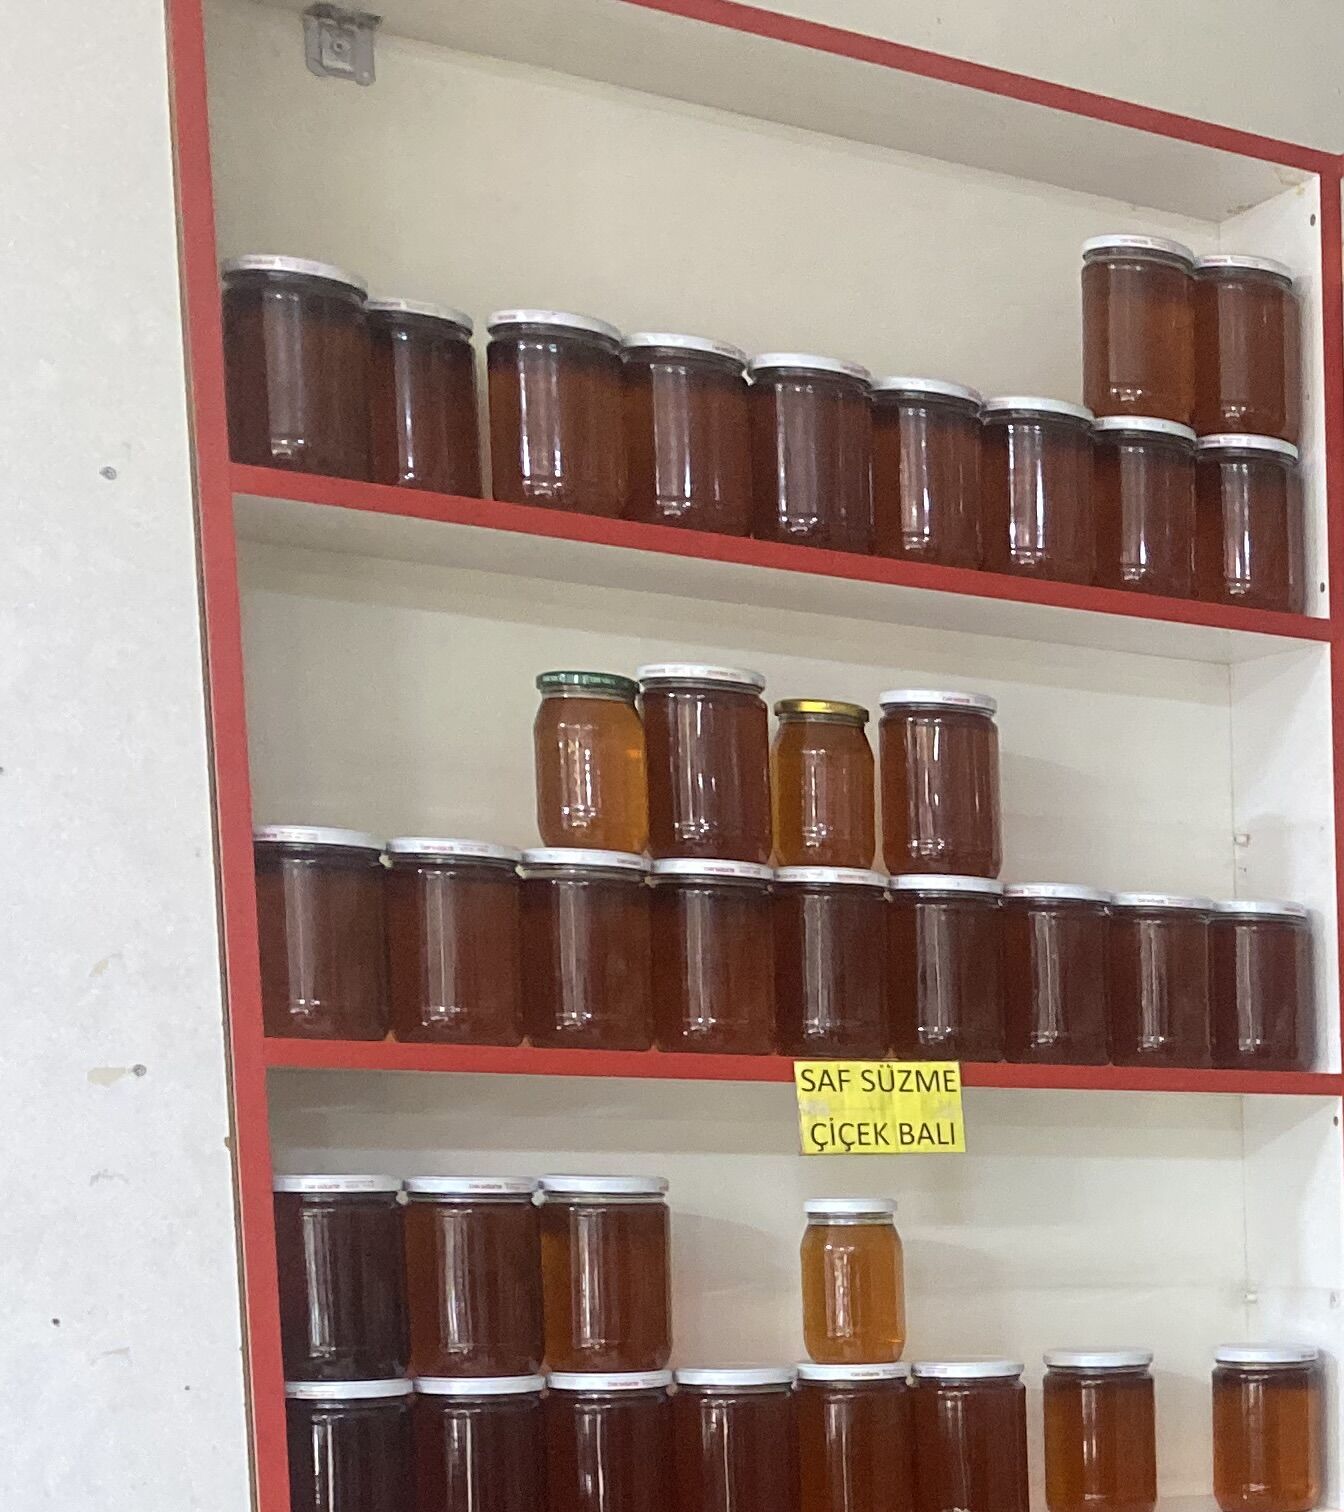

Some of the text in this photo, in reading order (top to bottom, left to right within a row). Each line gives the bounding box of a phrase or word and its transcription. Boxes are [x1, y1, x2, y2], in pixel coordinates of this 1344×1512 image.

[801, 1064, 958, 1093] SAF SÜZME
[810, 1117, 956, 1151] ÇİÇEK BALI
